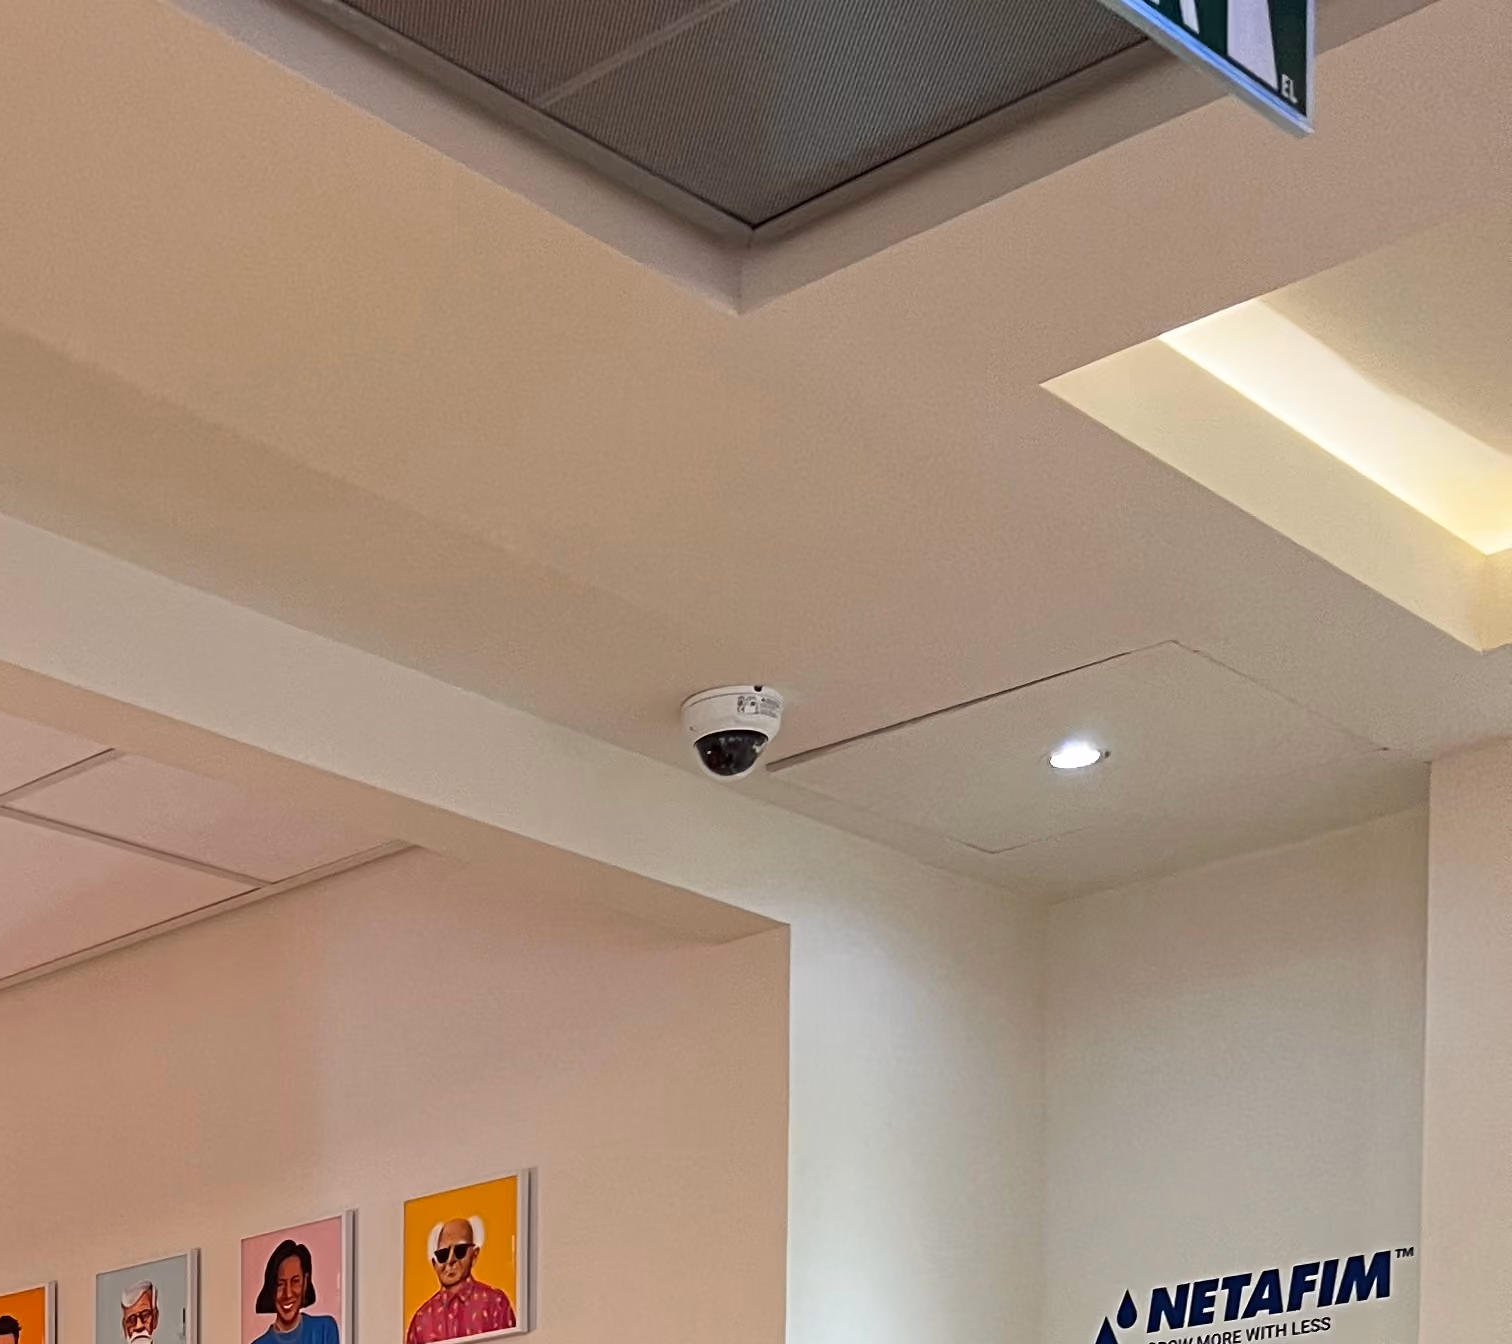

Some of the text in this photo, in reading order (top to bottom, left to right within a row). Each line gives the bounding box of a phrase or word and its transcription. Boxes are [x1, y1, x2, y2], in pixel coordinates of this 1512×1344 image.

[1147, 1251, 1392, 1333] NETAFIM
[1246, 1323, 1287, 1341] WITH
[1292, 1317, 1331, 1335] LESS
